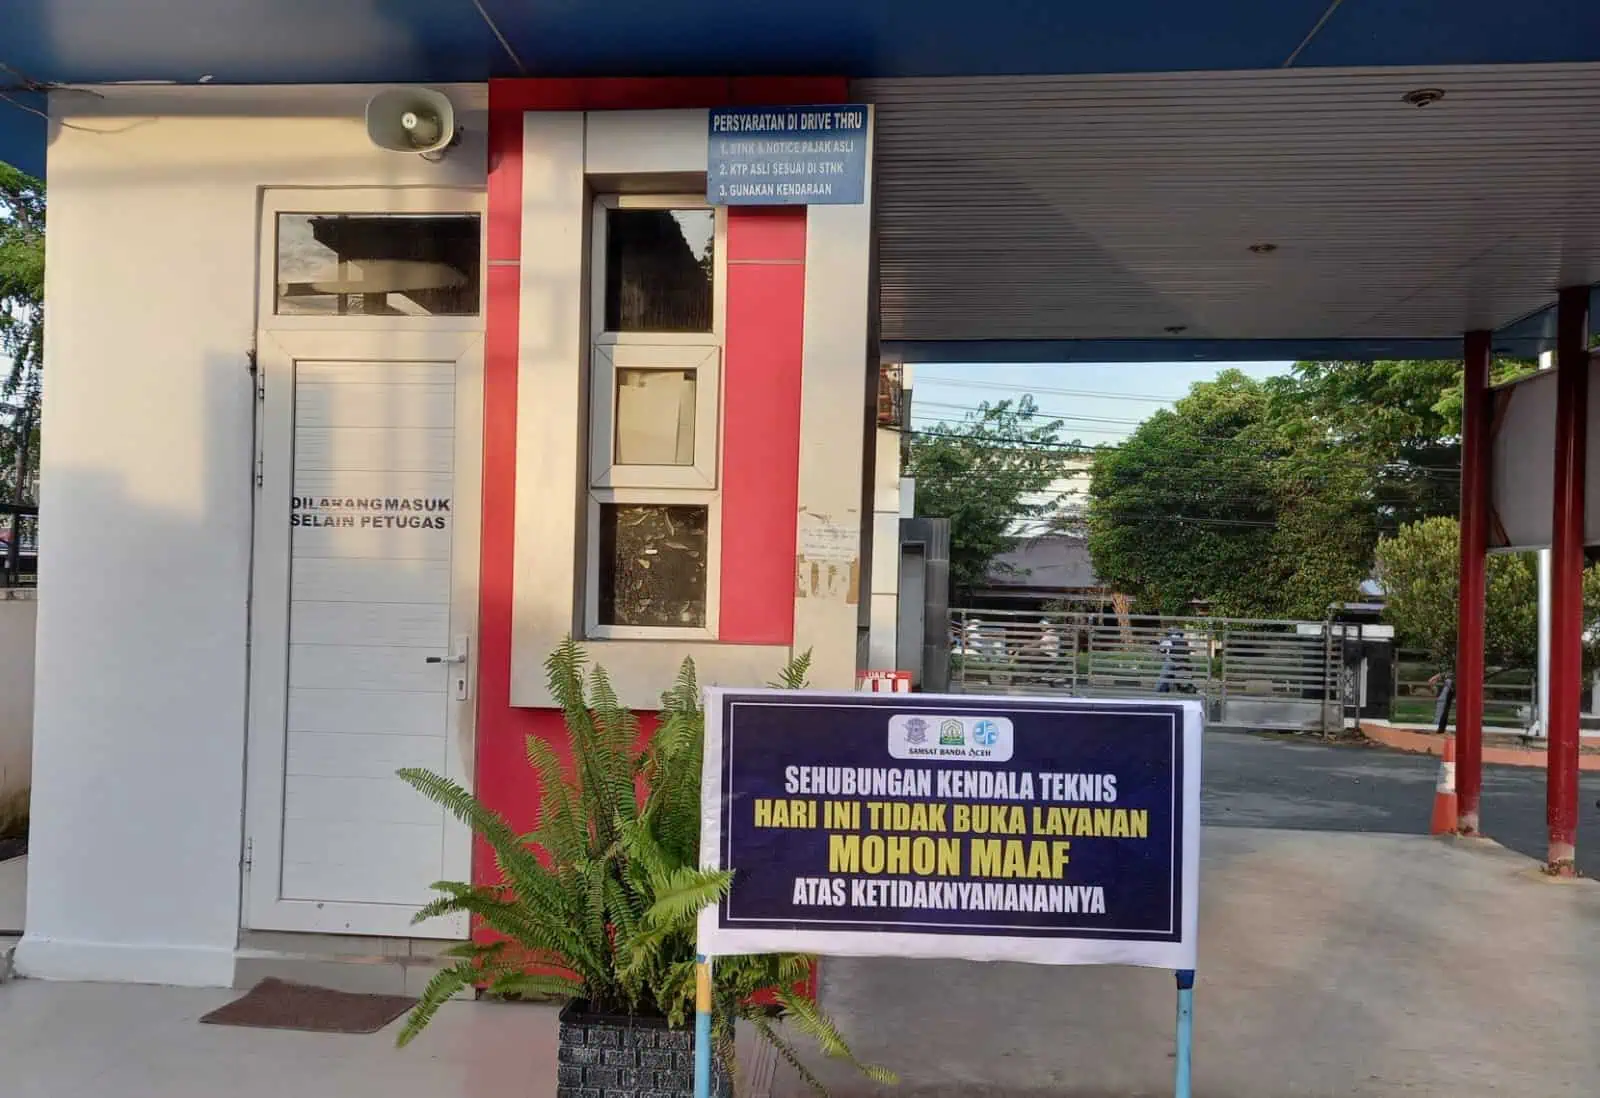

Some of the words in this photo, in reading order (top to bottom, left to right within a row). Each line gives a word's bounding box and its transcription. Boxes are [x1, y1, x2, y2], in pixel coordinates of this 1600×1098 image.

[713, 112, 785, 132] PERSYARATAN
[787, 113, 798, 130] DI
[801, 112, 831, 130] DRIVE
[835, 111, 862, 129] THRU
[766, 142, 800, 154] NOTICE
[802, 141, 830, 153] PAJAK
[831, 140, 854, 153] ASLI
[719, 164, 728, 175] 2.
[730, 163, 748, 175] KTP
[750, 163, 770, 175] ASLI
[772, 162, 805, 175] SESUAI
[807, 162, 816, 174] DI
[820, 161, 844, 174] STNK
[719, 185, 728, 196] 3.
[730, 183, 774, 196] GUNAKAN
[776, 183, 832, 195] KENDARAAN
[290, 514, 354, 527] SELAIN
[361, 516, 445, 529] PETUGAS
[909, 747, 937, 755] SAMSAT
[940, 748, 966, 756] BANDA
[968, 748, 991, 758] ACEH
[784, 766, 932, 798] SEHUBUNGAN
[937, 770, 1035, 800] KENDALA
[1039, 773, 1117, 802] TEKNIS
[754, 800, 817, 829] HARI
[824, 801, 860, 830] INI
[867, 802, 947, 833] TIDAK
[953, 804, 1027, 835] BUKA
[1032, 806, 1148, 838] LAYANAN
[828, 834, 961, 876] MOHON
[970, 838, 1071, 879] MAAF
[793, 877, 846, 907] ATAS
[851, 879, 1106, 914] KETIDAKNYAMANANNYA
